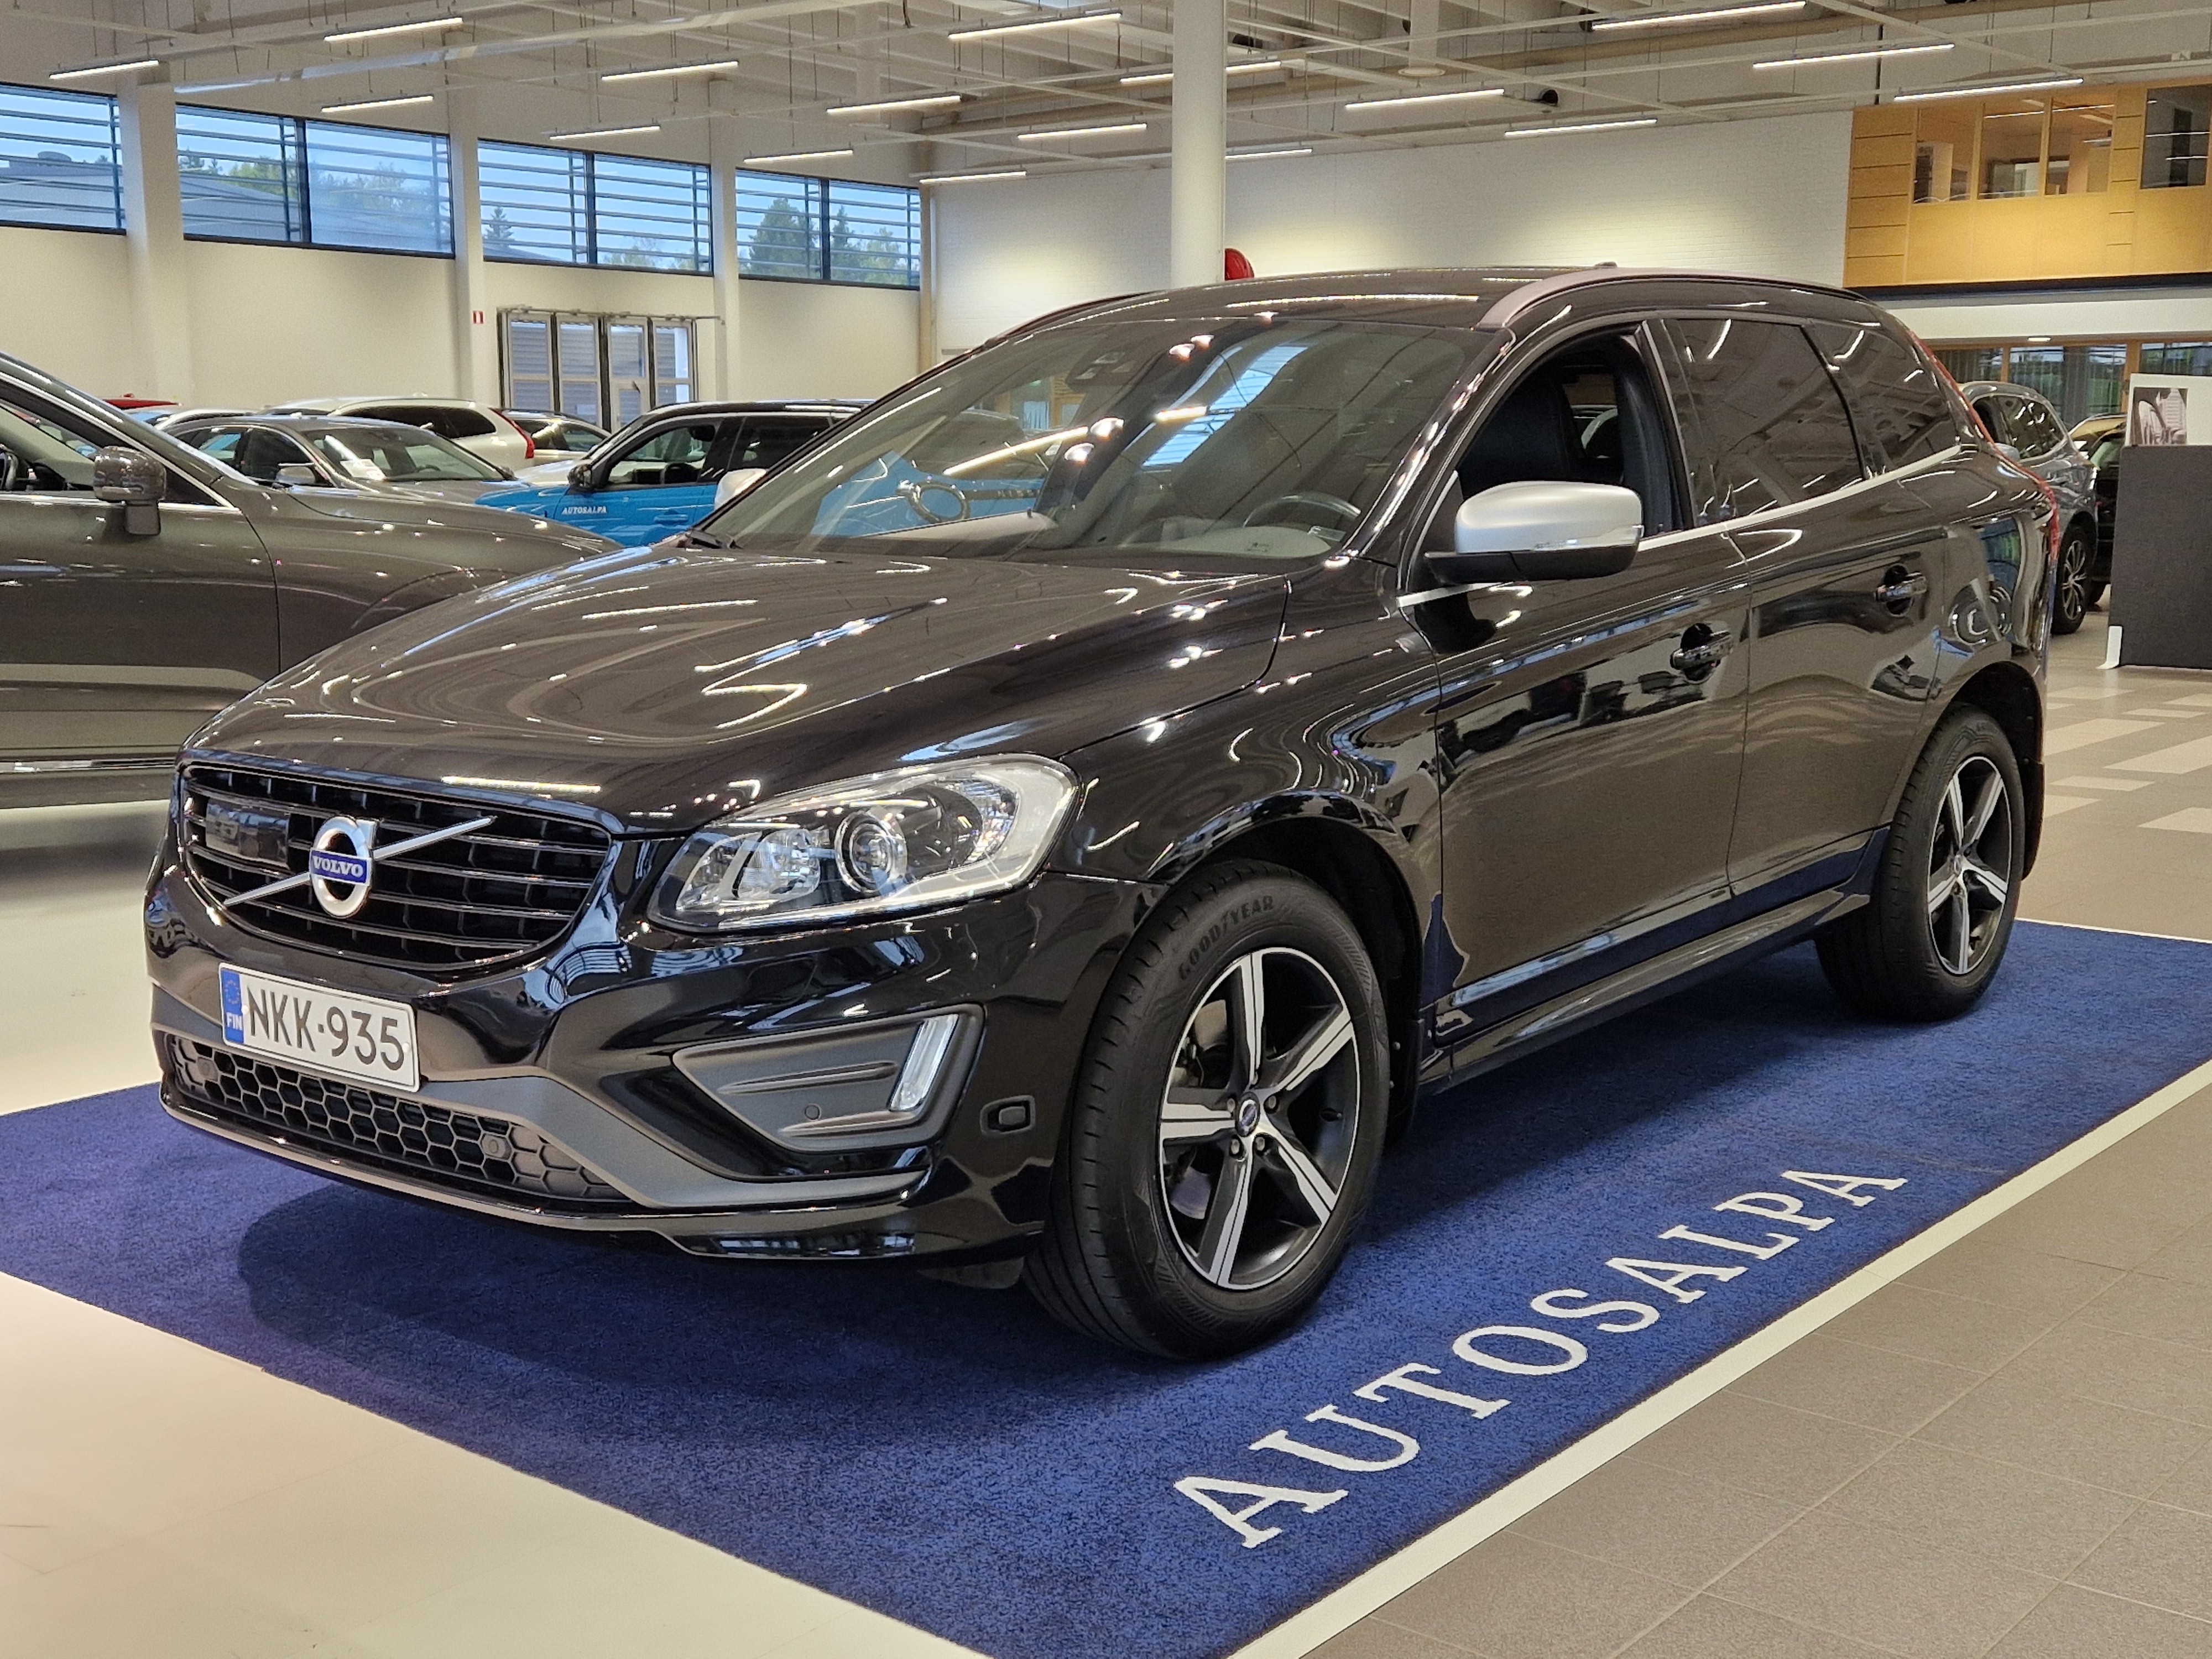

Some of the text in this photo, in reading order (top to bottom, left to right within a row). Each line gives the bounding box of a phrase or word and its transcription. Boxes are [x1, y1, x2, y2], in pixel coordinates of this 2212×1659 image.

[561, 505, 607, 515] AUTOSALPA
[312, 855, 364, 878] VOLVO
[226, 1012, 243, 1031] FIN
[247, 985, 405, 1071] NKK-935
[1172, 1169, 1909, 1549] AUTOSALPA
